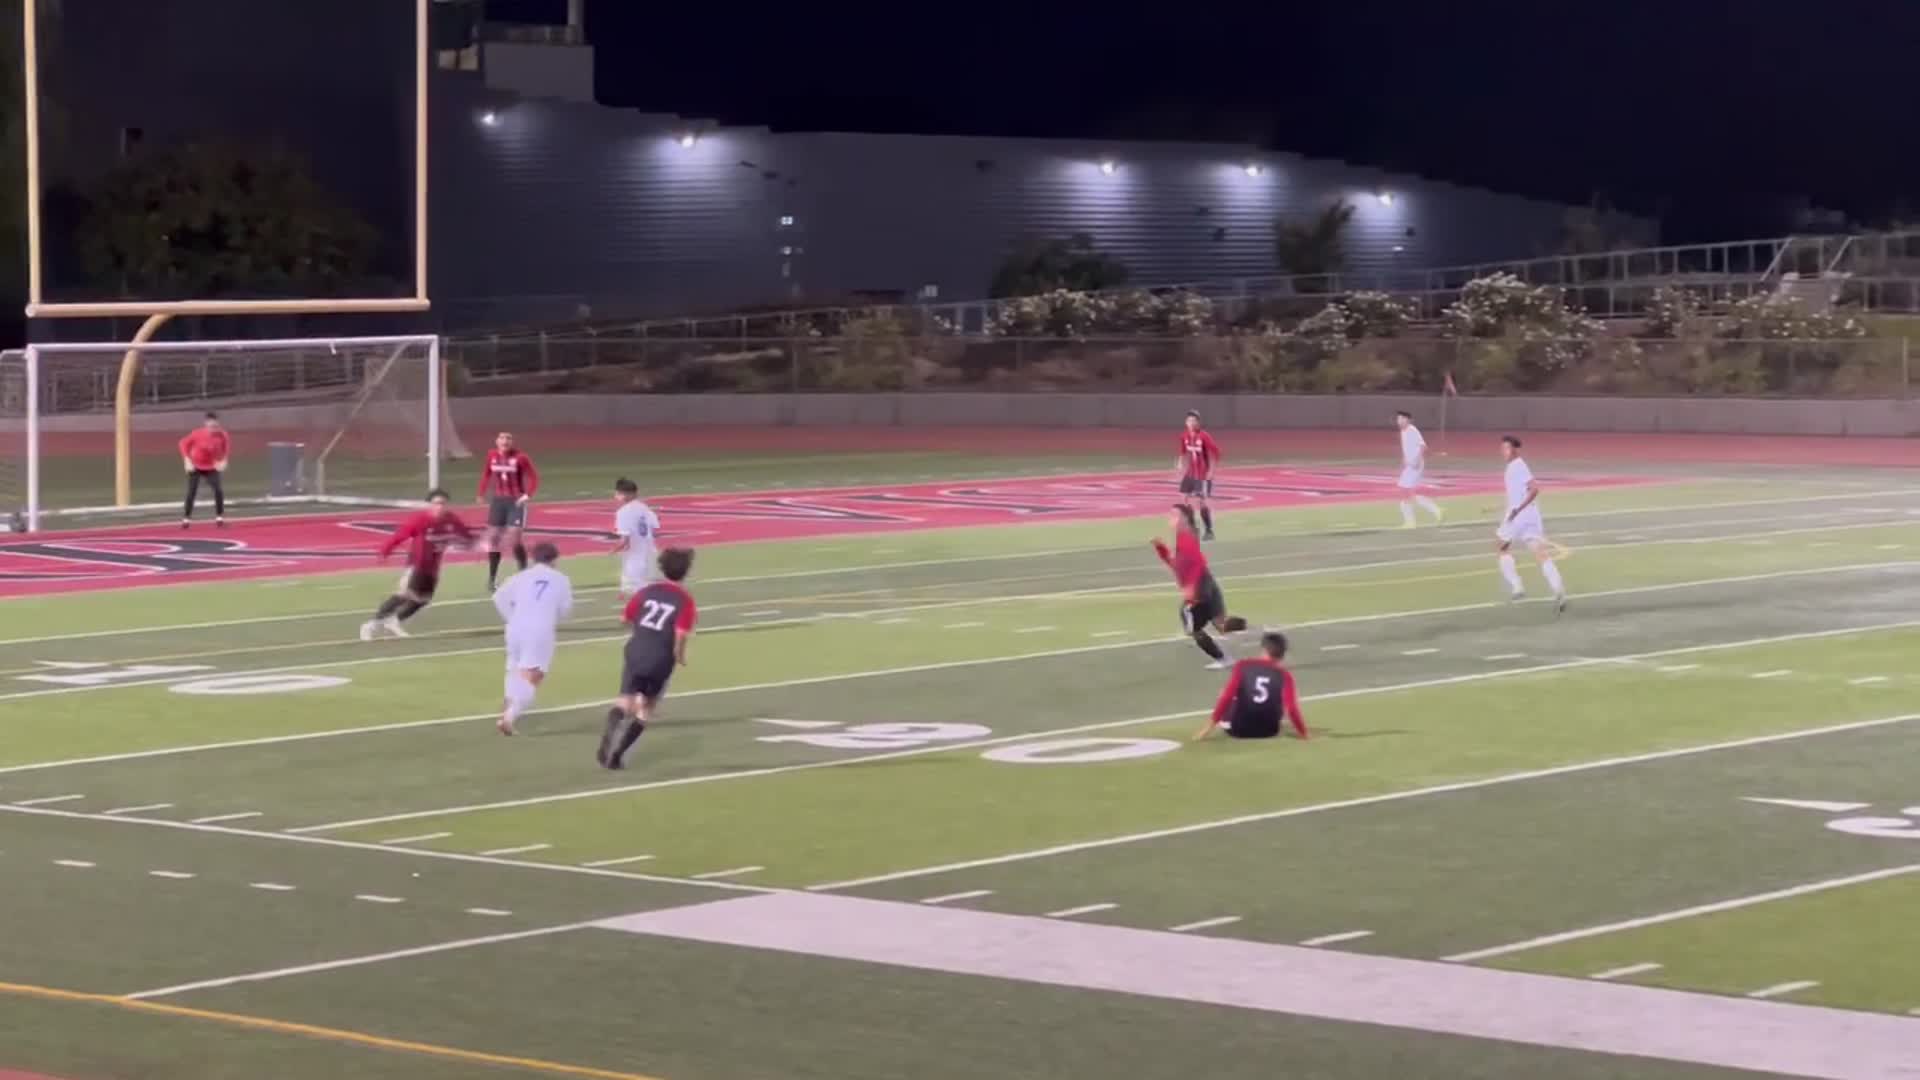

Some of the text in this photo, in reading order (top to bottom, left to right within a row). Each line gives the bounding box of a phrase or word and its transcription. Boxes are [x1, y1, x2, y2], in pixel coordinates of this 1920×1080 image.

[534, 580, 549, 601] 7
[640, 600, 675, 631] 27
[1252, 676, 1271, 704] 5
